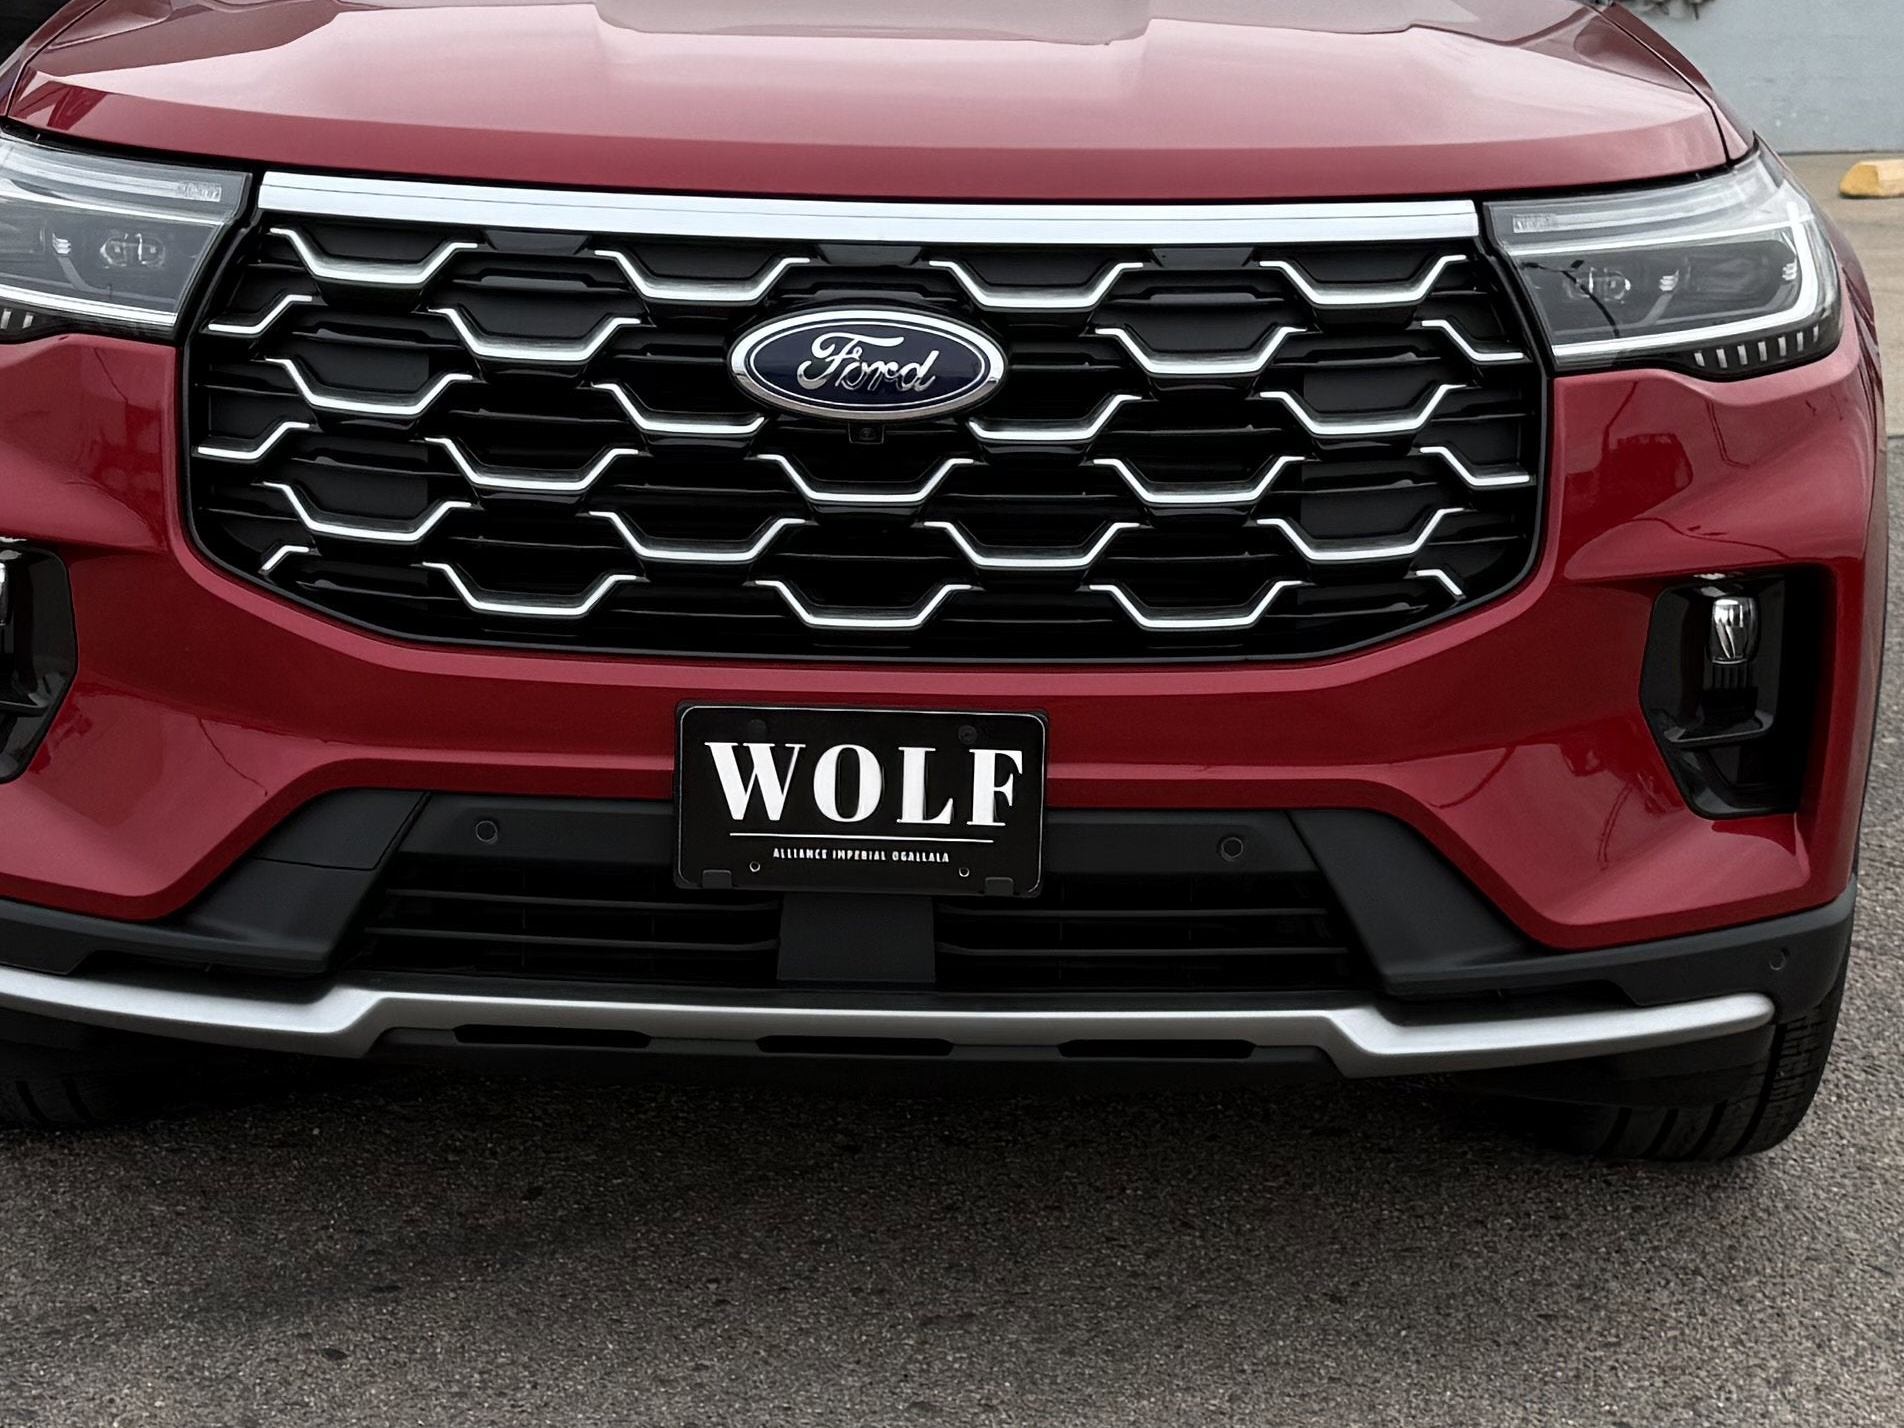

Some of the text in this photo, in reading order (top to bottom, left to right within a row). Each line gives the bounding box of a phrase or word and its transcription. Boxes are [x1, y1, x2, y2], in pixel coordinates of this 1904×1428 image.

[796, 331, 940, 393] Ford
[703, 740, 1024, 827] WOLF
[772, 847, 828, 860] ALLIANCE
[891, 851, 950, 863] OGALLALA
